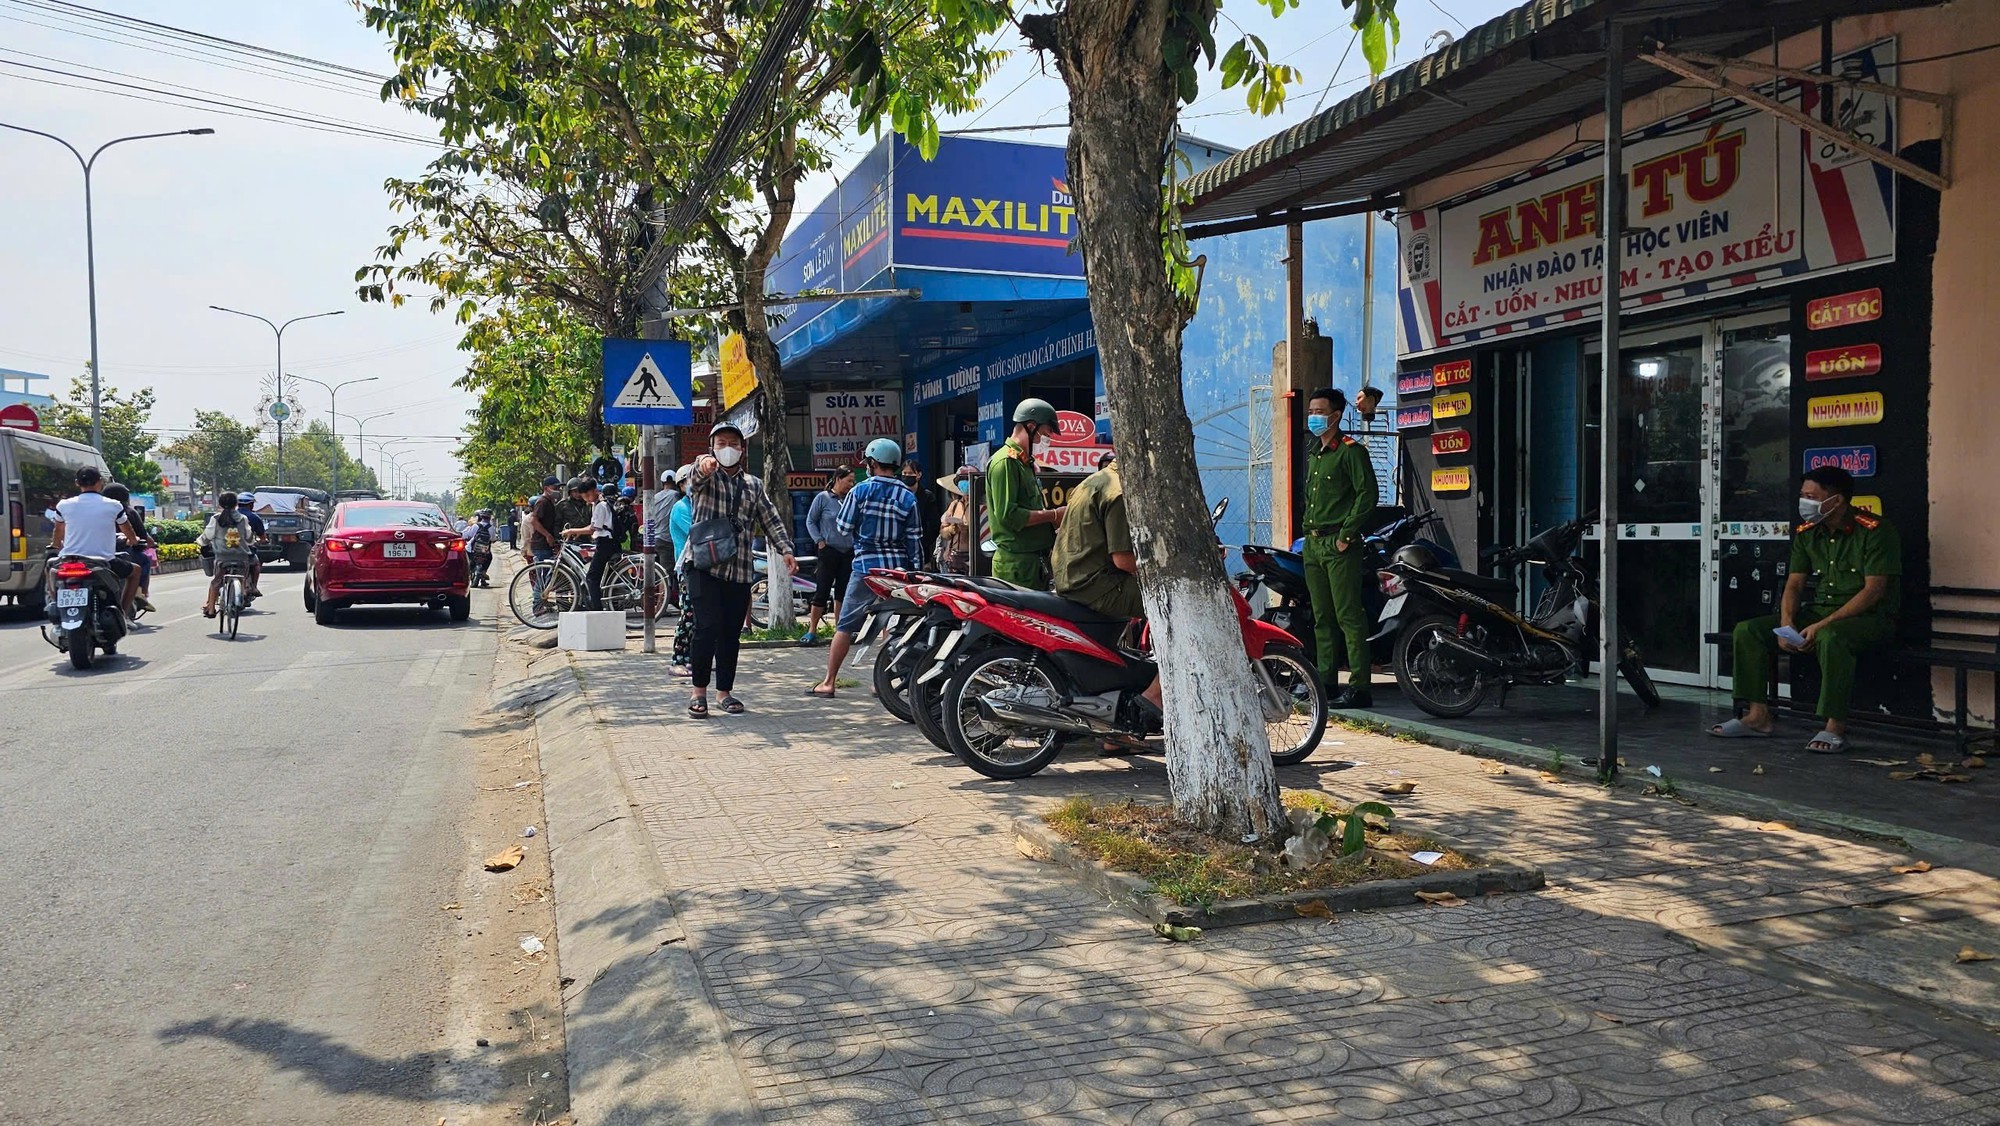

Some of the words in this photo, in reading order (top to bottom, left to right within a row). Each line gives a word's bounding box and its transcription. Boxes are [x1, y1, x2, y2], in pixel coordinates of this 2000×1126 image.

[1632, 121, 1747, 219] TÚ
[907, 193, 1076, 235] MAXILIT
[843, 200, 887, 260] MAXILITE
[815, 248, 822, 276] LÊ
[822, 242, 835, 269] DUY
[1483, 262, 1532, 294] NHẬN
[1536, 251, 1576, 280] ĐÀO
[1581, 245, 1606, 272] TẠ
[1626, 226, 1670, 258] HỌC
[1676, 209, 1729, 243] VIÊN
[1444, 300, 1481, 329] CẮT
[1494, 288, 1539, 316] UỐN
[1553, 267, 1639, 304] NHUM
[1659, 250, 1715, 281] TẠO
[1721, 223, 1796, 267] KIỂU
[1810, 300, 1843, 325] CẮT
[1847, 296, 1879, 318] TÓC
[1022, 349, 1038, 371] CAO
[1038, 336, 1055, 365] CẤP
[1056, 331, 1084, 359] CHÍNH
[1820, 352, 1867, 375] UỐN
[1435, 368, 1452, 383] CẮT
[1453, 366, 1470, 379] TÓC
[825, 391, 859, 409] SỬA
[864, 395, 886, 408] XE
[1812, 400, 1851, 423] NHUỘM
[1854, 397, 1879, 417] MÀU
[815, 411, 858, 438] HOÀI
[862, 410, 898, 436] TÂM
[1057, 418, 1086, 433] OVA
[829, 442, 838, 452] XE
[1440, 435, 1463, 449] UỐN
[1840, 450, 1871, 475] MẶT
[789, 477, 826, 488] JOTUN
